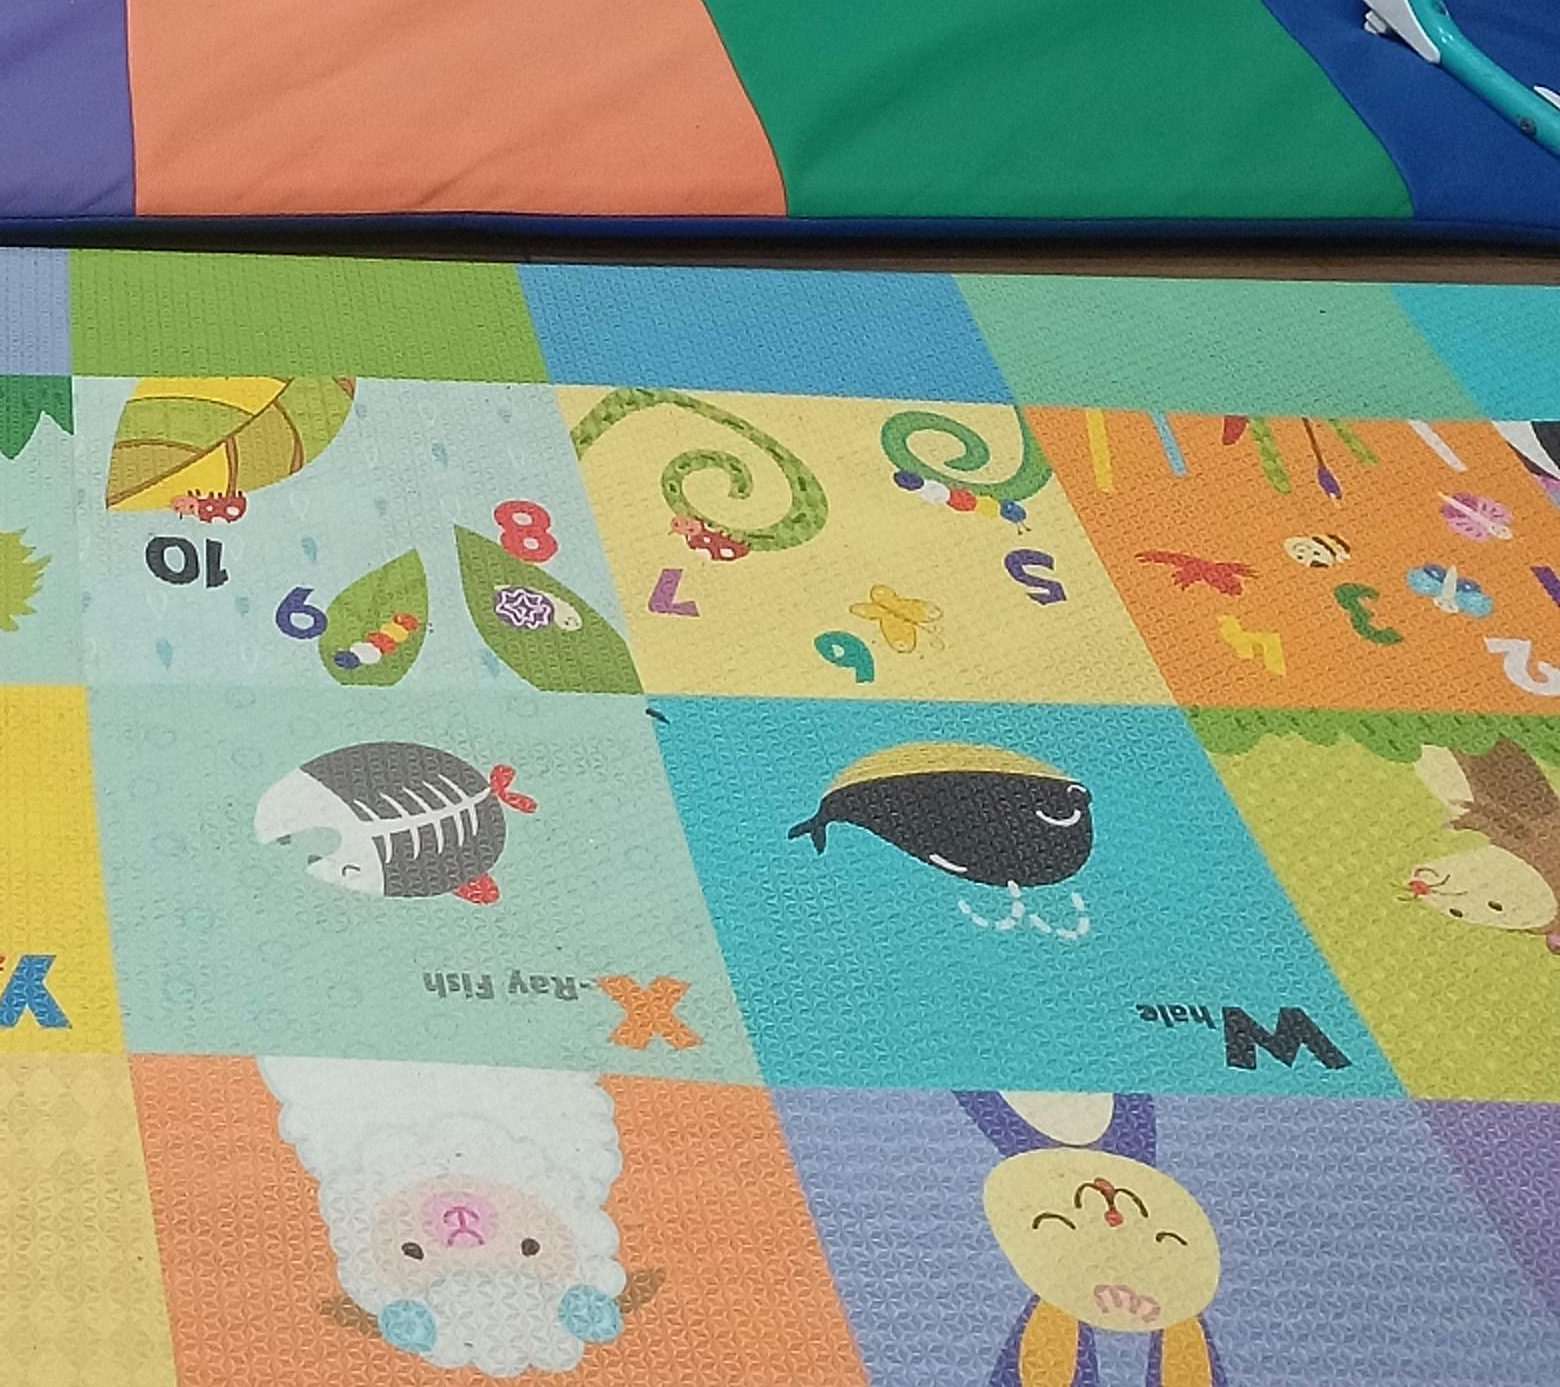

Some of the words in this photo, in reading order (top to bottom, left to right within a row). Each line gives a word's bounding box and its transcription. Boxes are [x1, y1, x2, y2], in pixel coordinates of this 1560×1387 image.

[492, 499, 560, 563] 8
[144, 535, 229, 589] 10
[1003, 549, 1068, 606] 5
[274, 586, 328, 639] 9
[646, 568, 700, 617] 7
[1333, 582, 1405, 647] 3
[813, 629, 875, 684] 6
[1216, 615, 1287, 677] 4
[422, 968, 494, 1000] Fish
